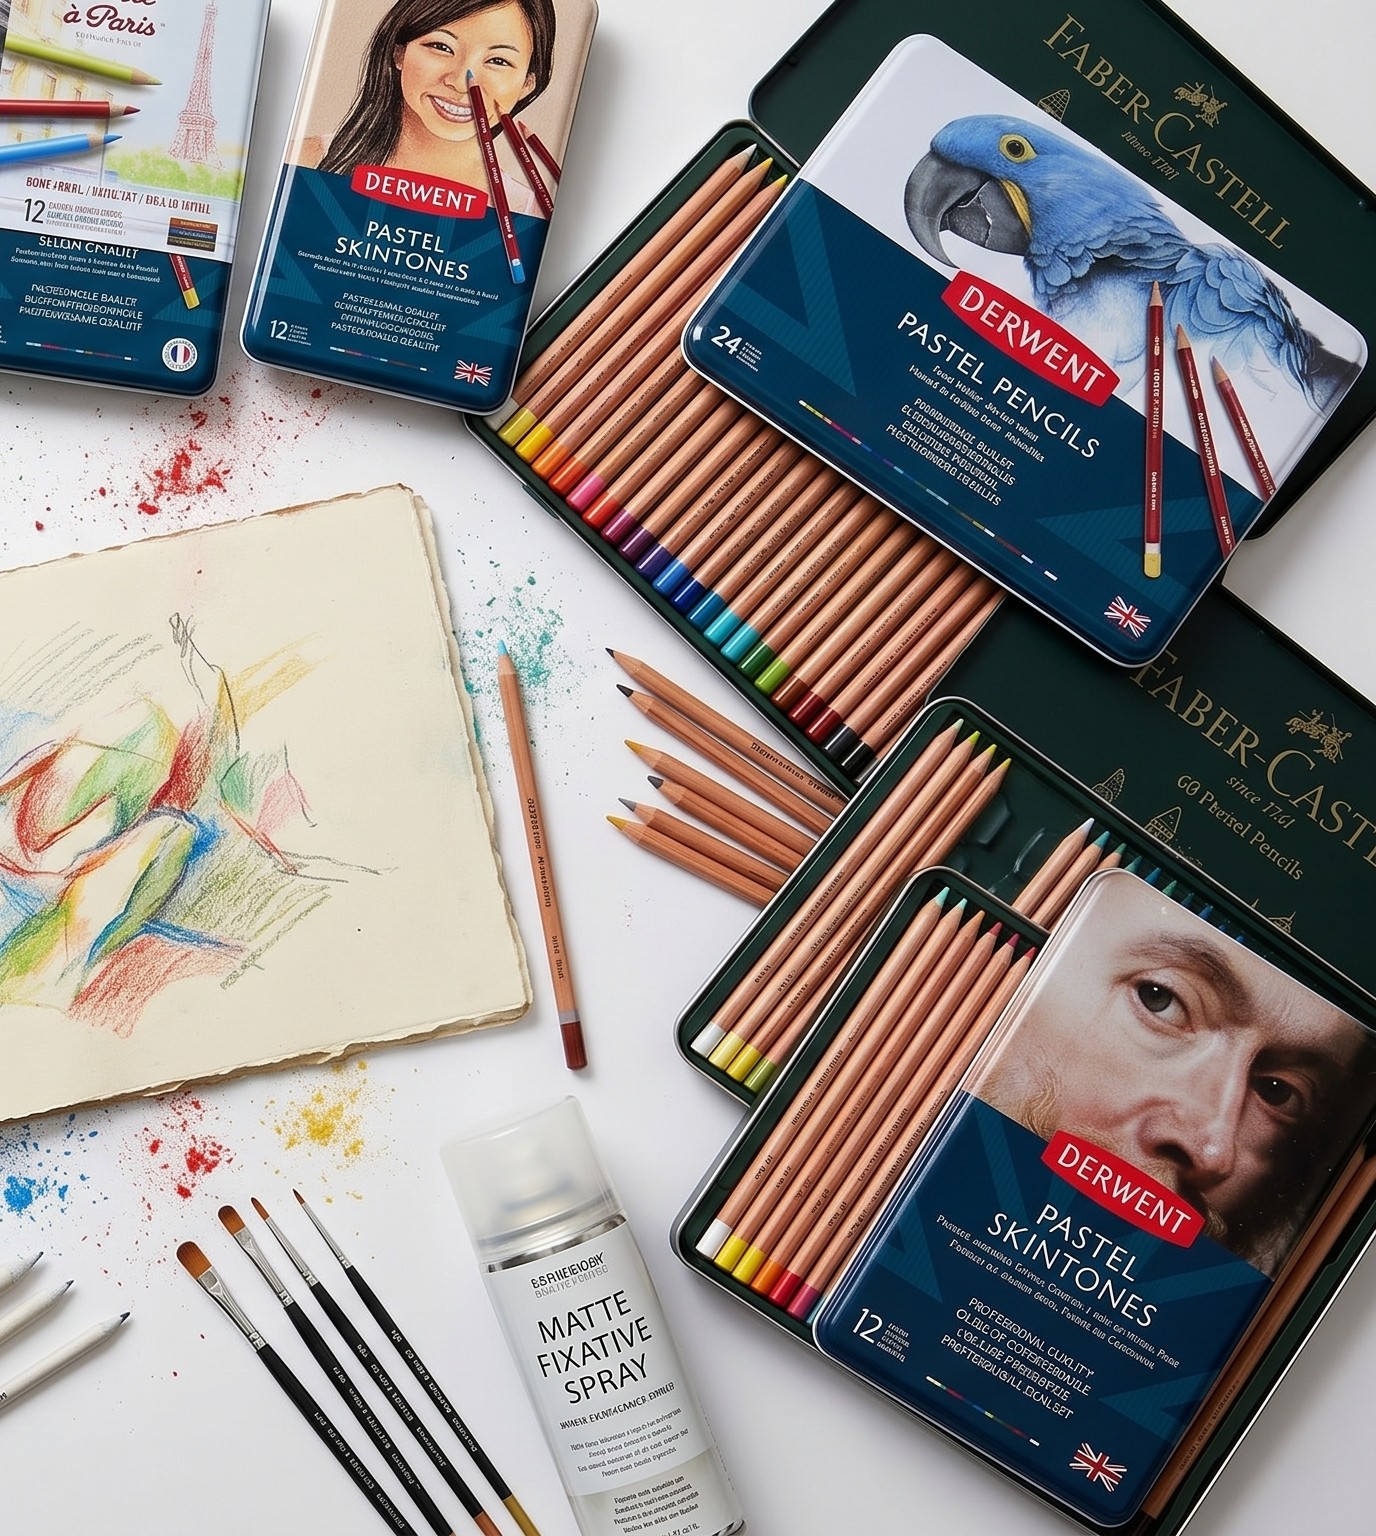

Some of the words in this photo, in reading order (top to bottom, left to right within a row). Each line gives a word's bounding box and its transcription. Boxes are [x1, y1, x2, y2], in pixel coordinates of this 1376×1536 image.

[86, 4, 156, 36] Paris
[1043, 13, 1291, 250] FABER-CASTELL
[24, 198, 46, 224] 12
[365, 172, 477, 212] DERWENT
[335, 237, 470, 281] SKINTONES
[366, 220, 445, 253] PASTEL
[270, 319, 288, 340] 12
[711, 325, 743, 355] 24
[958, 285, 1105, 392] DERWENT
[897, 312, 985, 385] PASTEL
[993, 377, 1100, 458] PENCILS
[1226, 775, 1261, 804] since
[1250, 831, 1303, 881] Pencils
[1057, 1143, 1192, 1234] DERWENT
[1036, 1203, 1137, 1282] PASTEL
[987, 1213, 1158, 1327] SKINTONES
[537, 1289, 632, 1344] MATTE
[851, 1308, 883, 1344] 12
[536, 1316, 652, 1378] FIXATIVE
[564, 1352, 648, 1405] SPRAY
